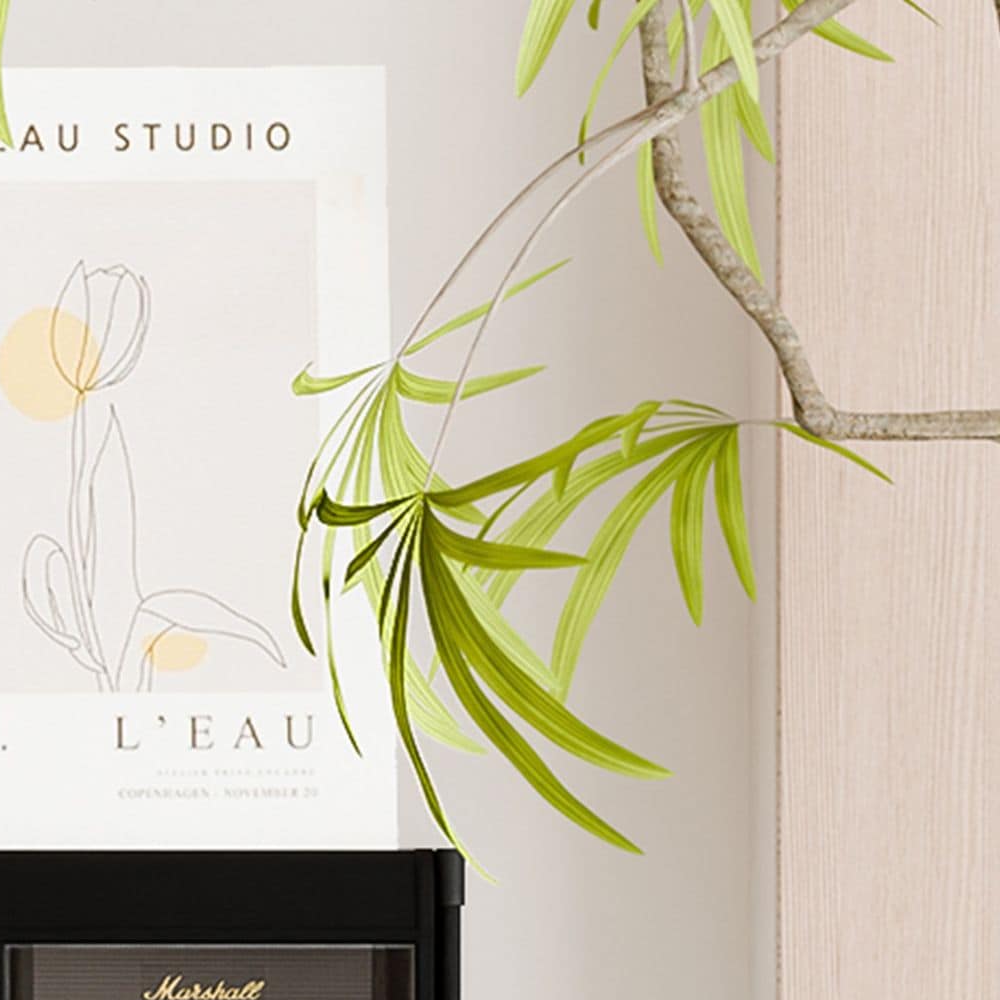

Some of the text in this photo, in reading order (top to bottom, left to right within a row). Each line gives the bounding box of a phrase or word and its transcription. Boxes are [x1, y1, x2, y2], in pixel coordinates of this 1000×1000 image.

[114, 121, 291, 152] STUDIO
[117, 787, 210, 799] COPENHAGEN
[224, 787, 300, 799] NOVEMBER
[143, 975, 265, 1000] Marshall
